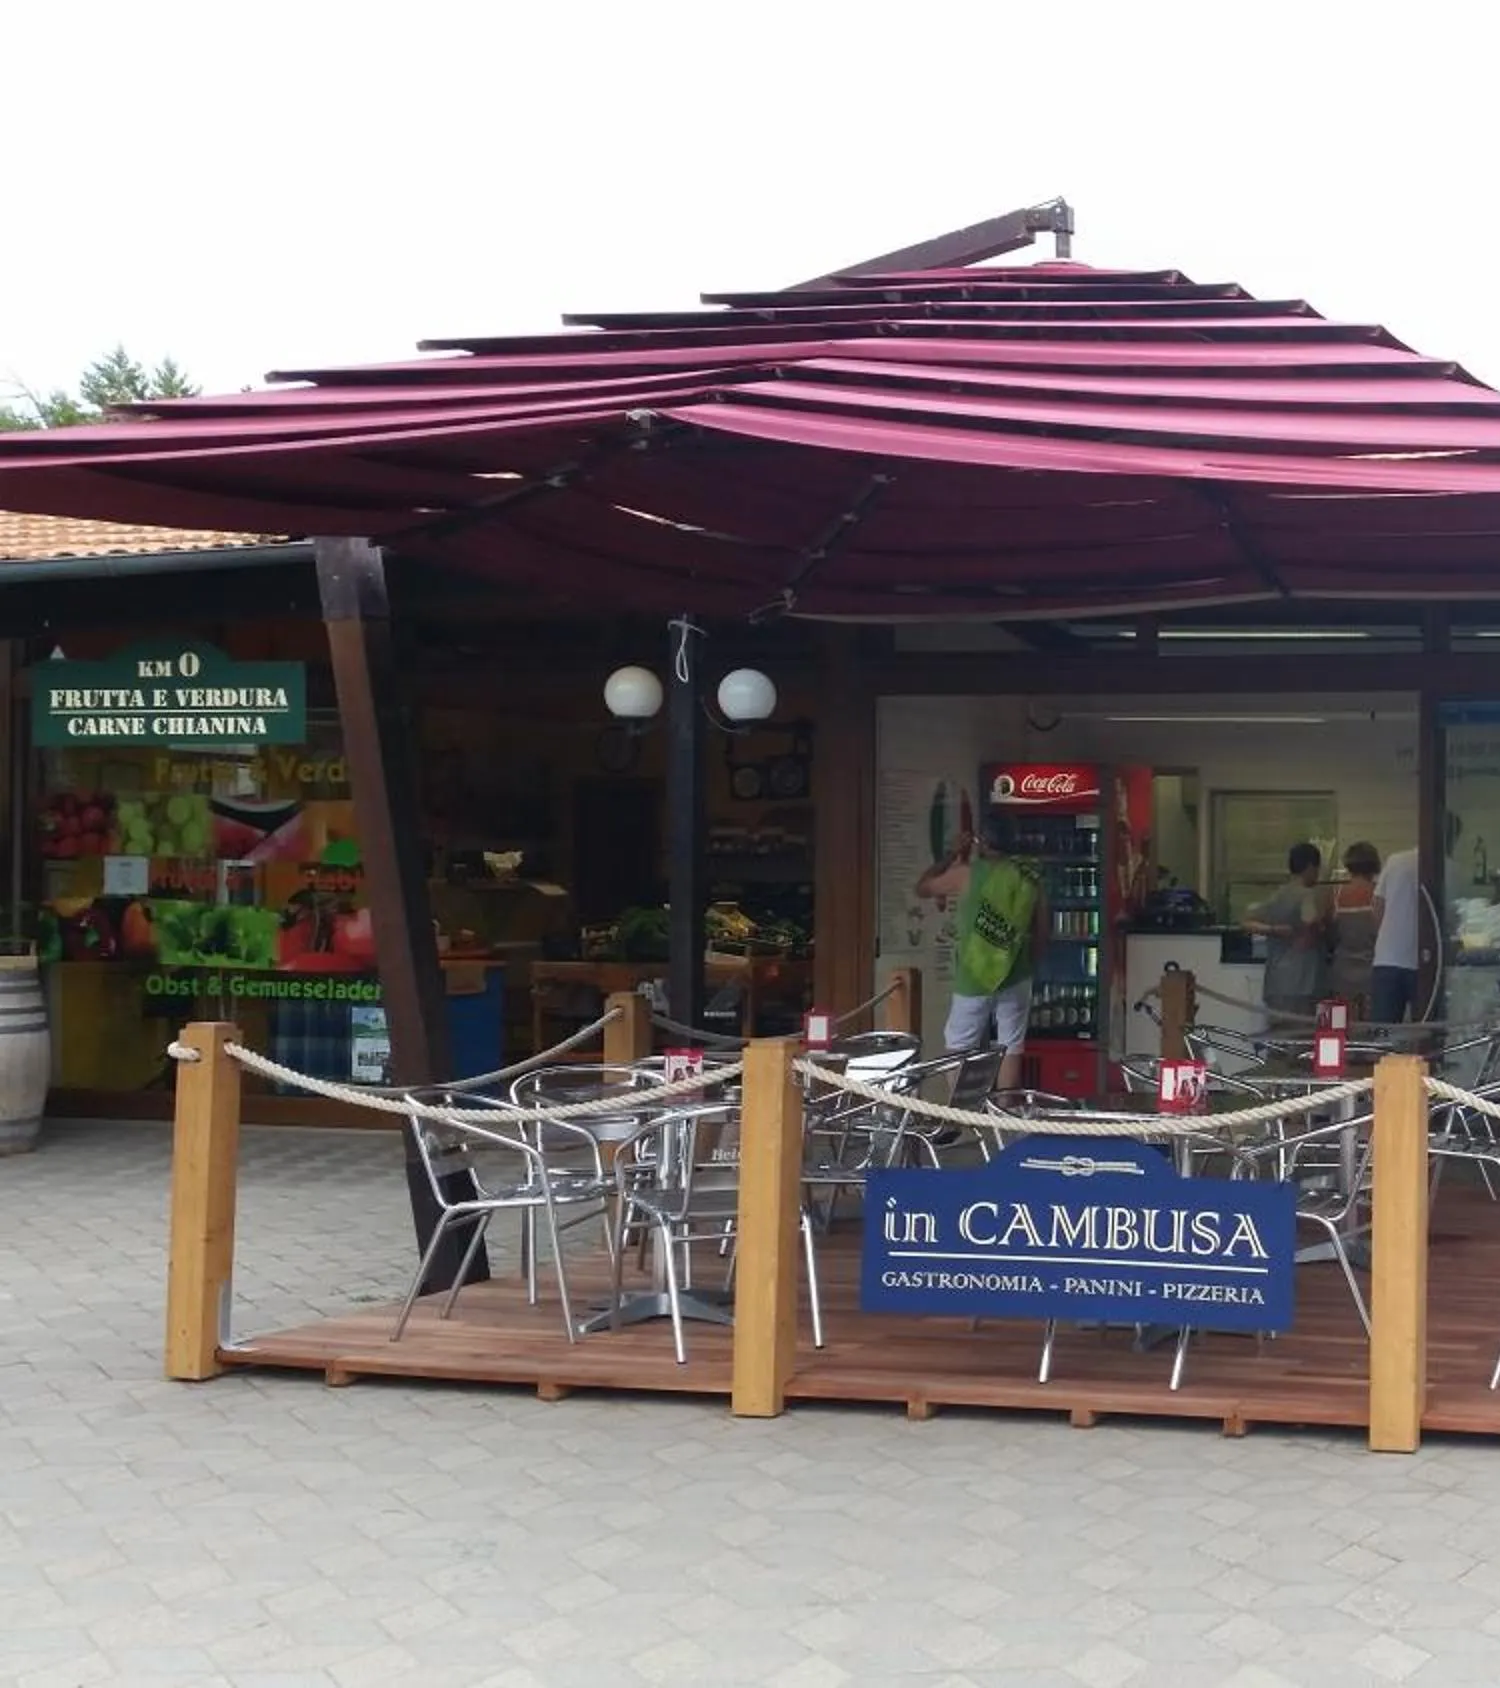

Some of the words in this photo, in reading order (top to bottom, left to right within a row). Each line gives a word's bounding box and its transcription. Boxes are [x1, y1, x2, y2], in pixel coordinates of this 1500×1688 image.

[137, 660, 172, 678] KM
[50, 688, 144, 709] FRUTTA
[153, 688, 168, 707] E
[175, 687, 288, 707] VERDURA
[67, 717, 145, 736] CARNE
[152, 716, 267, 735] CHIANINA
[146, 975, 199, 996] Obst
[207, 977, 222, 996] &
[883, 1197, 938, 1244] in
[958, 1201, 1269, 1259] CAMBUSA
[881, 1270, 1043, 1294] GASTRONOMIA
[1064, 1278, 1142, 1298] PANINI
[1163, 1281, 1265, 1304] PIZZERIA
